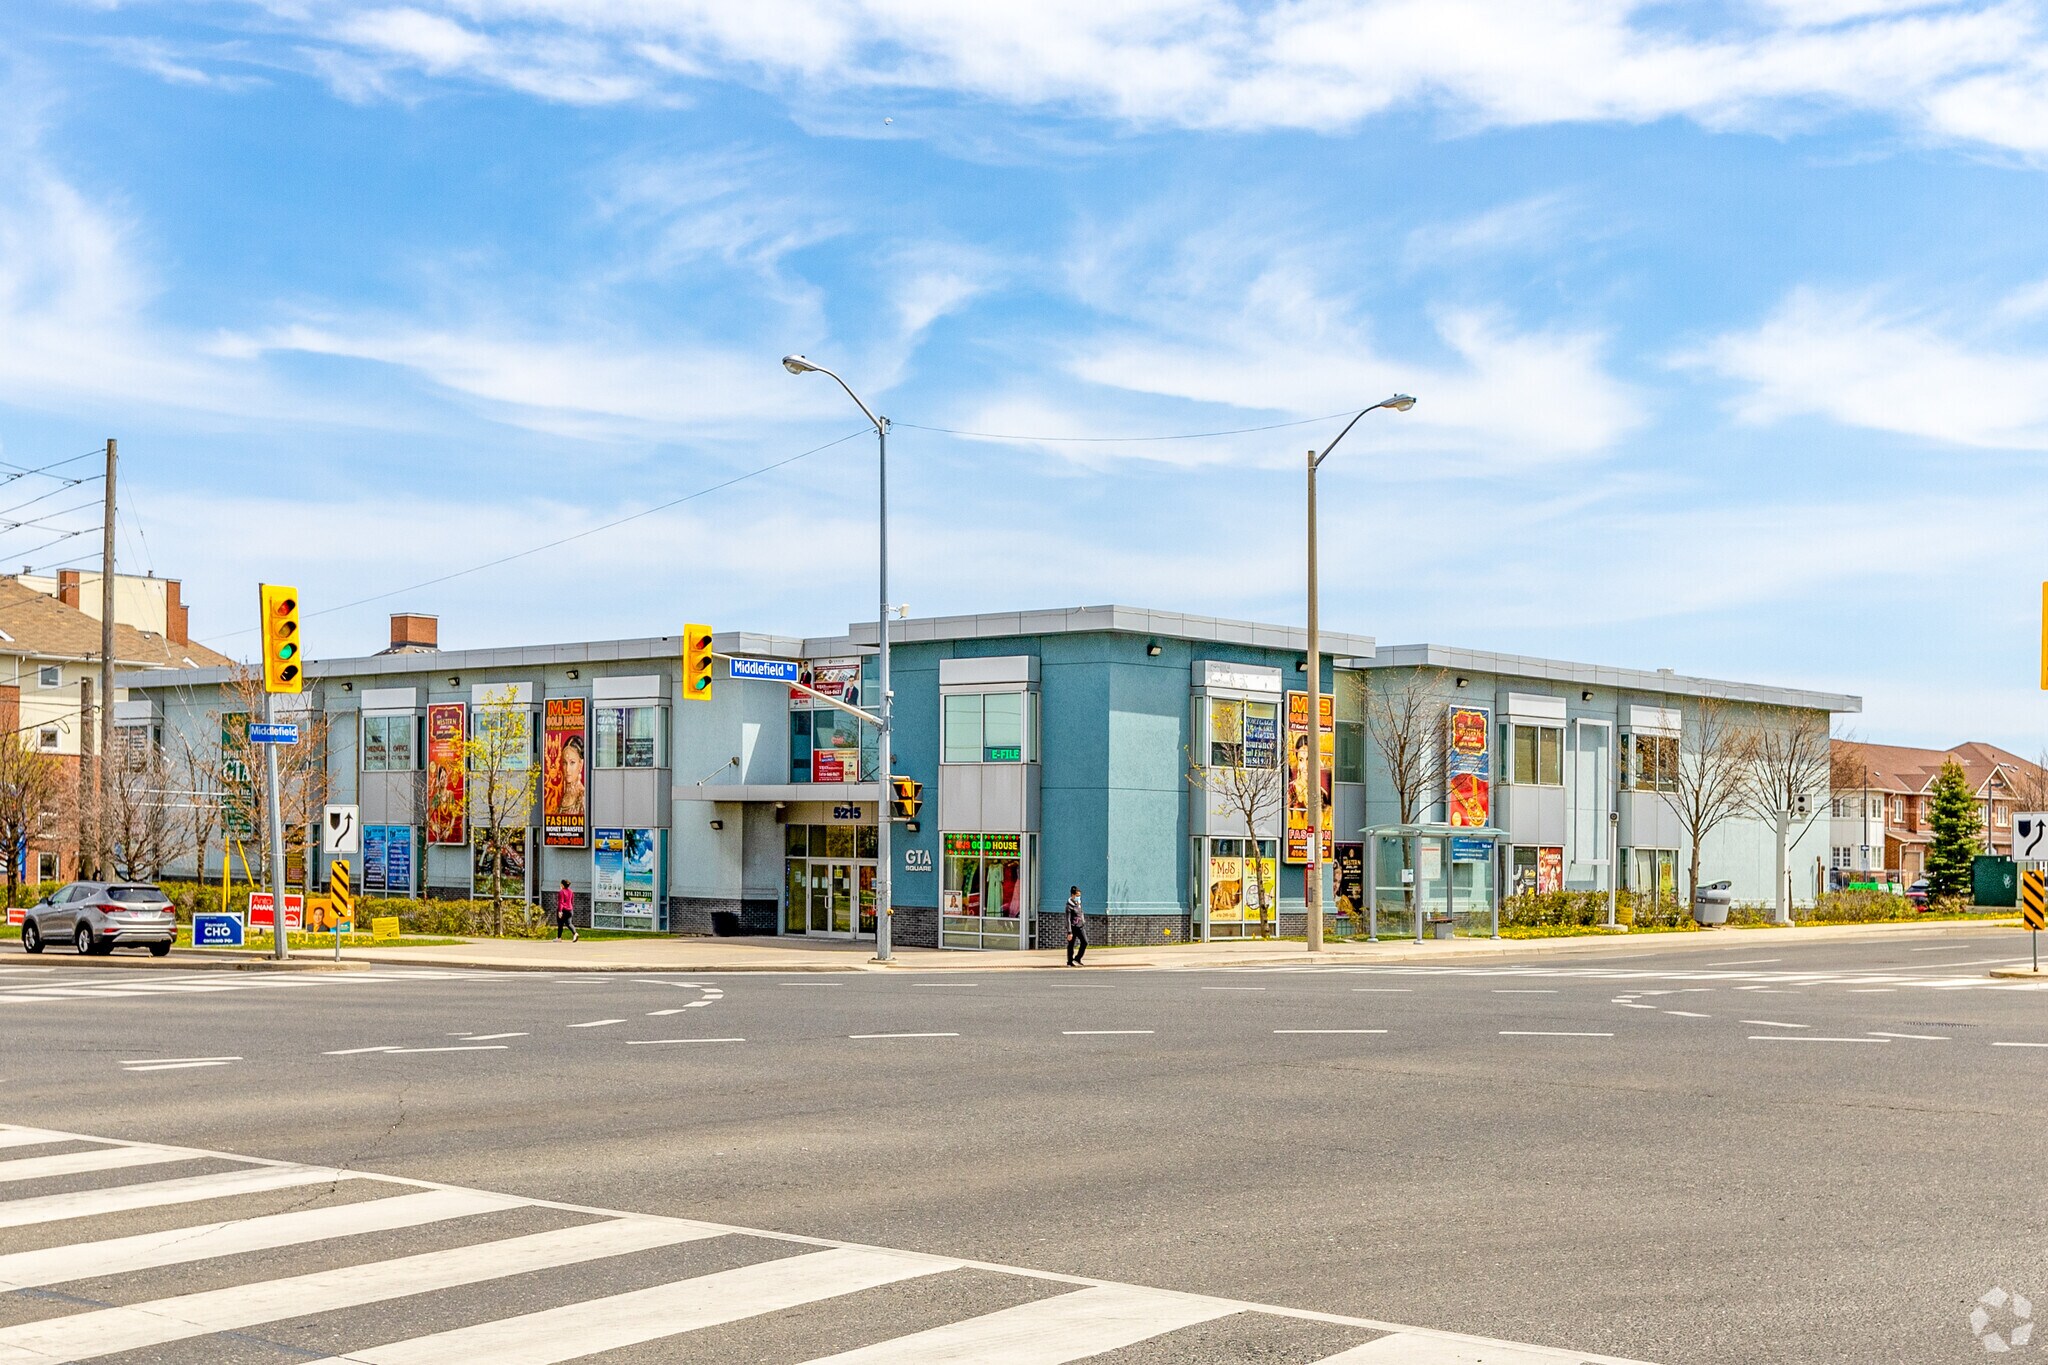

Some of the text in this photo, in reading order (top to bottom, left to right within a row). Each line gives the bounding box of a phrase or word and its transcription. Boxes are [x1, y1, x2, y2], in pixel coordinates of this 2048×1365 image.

[734, 661, 784, 676] Middlefield
[548, 700, 583, 716] MJS
[1291, 695, 1331, 716] MS
[546, 715, 563, 726] GOLD
[563, 715, 585, 726] HOUSE
[251, 726, 297, 737] Middlefield
[992, 749, 1019, 760] E-FILE
[833, 807, 862, 819] 5215
[546, 815, 584, 826] FASHION
[955, 840, 1018, 850] MJS GOLD HOUSE
[905, 849, 932, 864] GTA
[1217, 862, 1236, 875] MJS
[252, 903, 300, 912] ANANDAJAN
[204, 927, 231, 937] CHO
